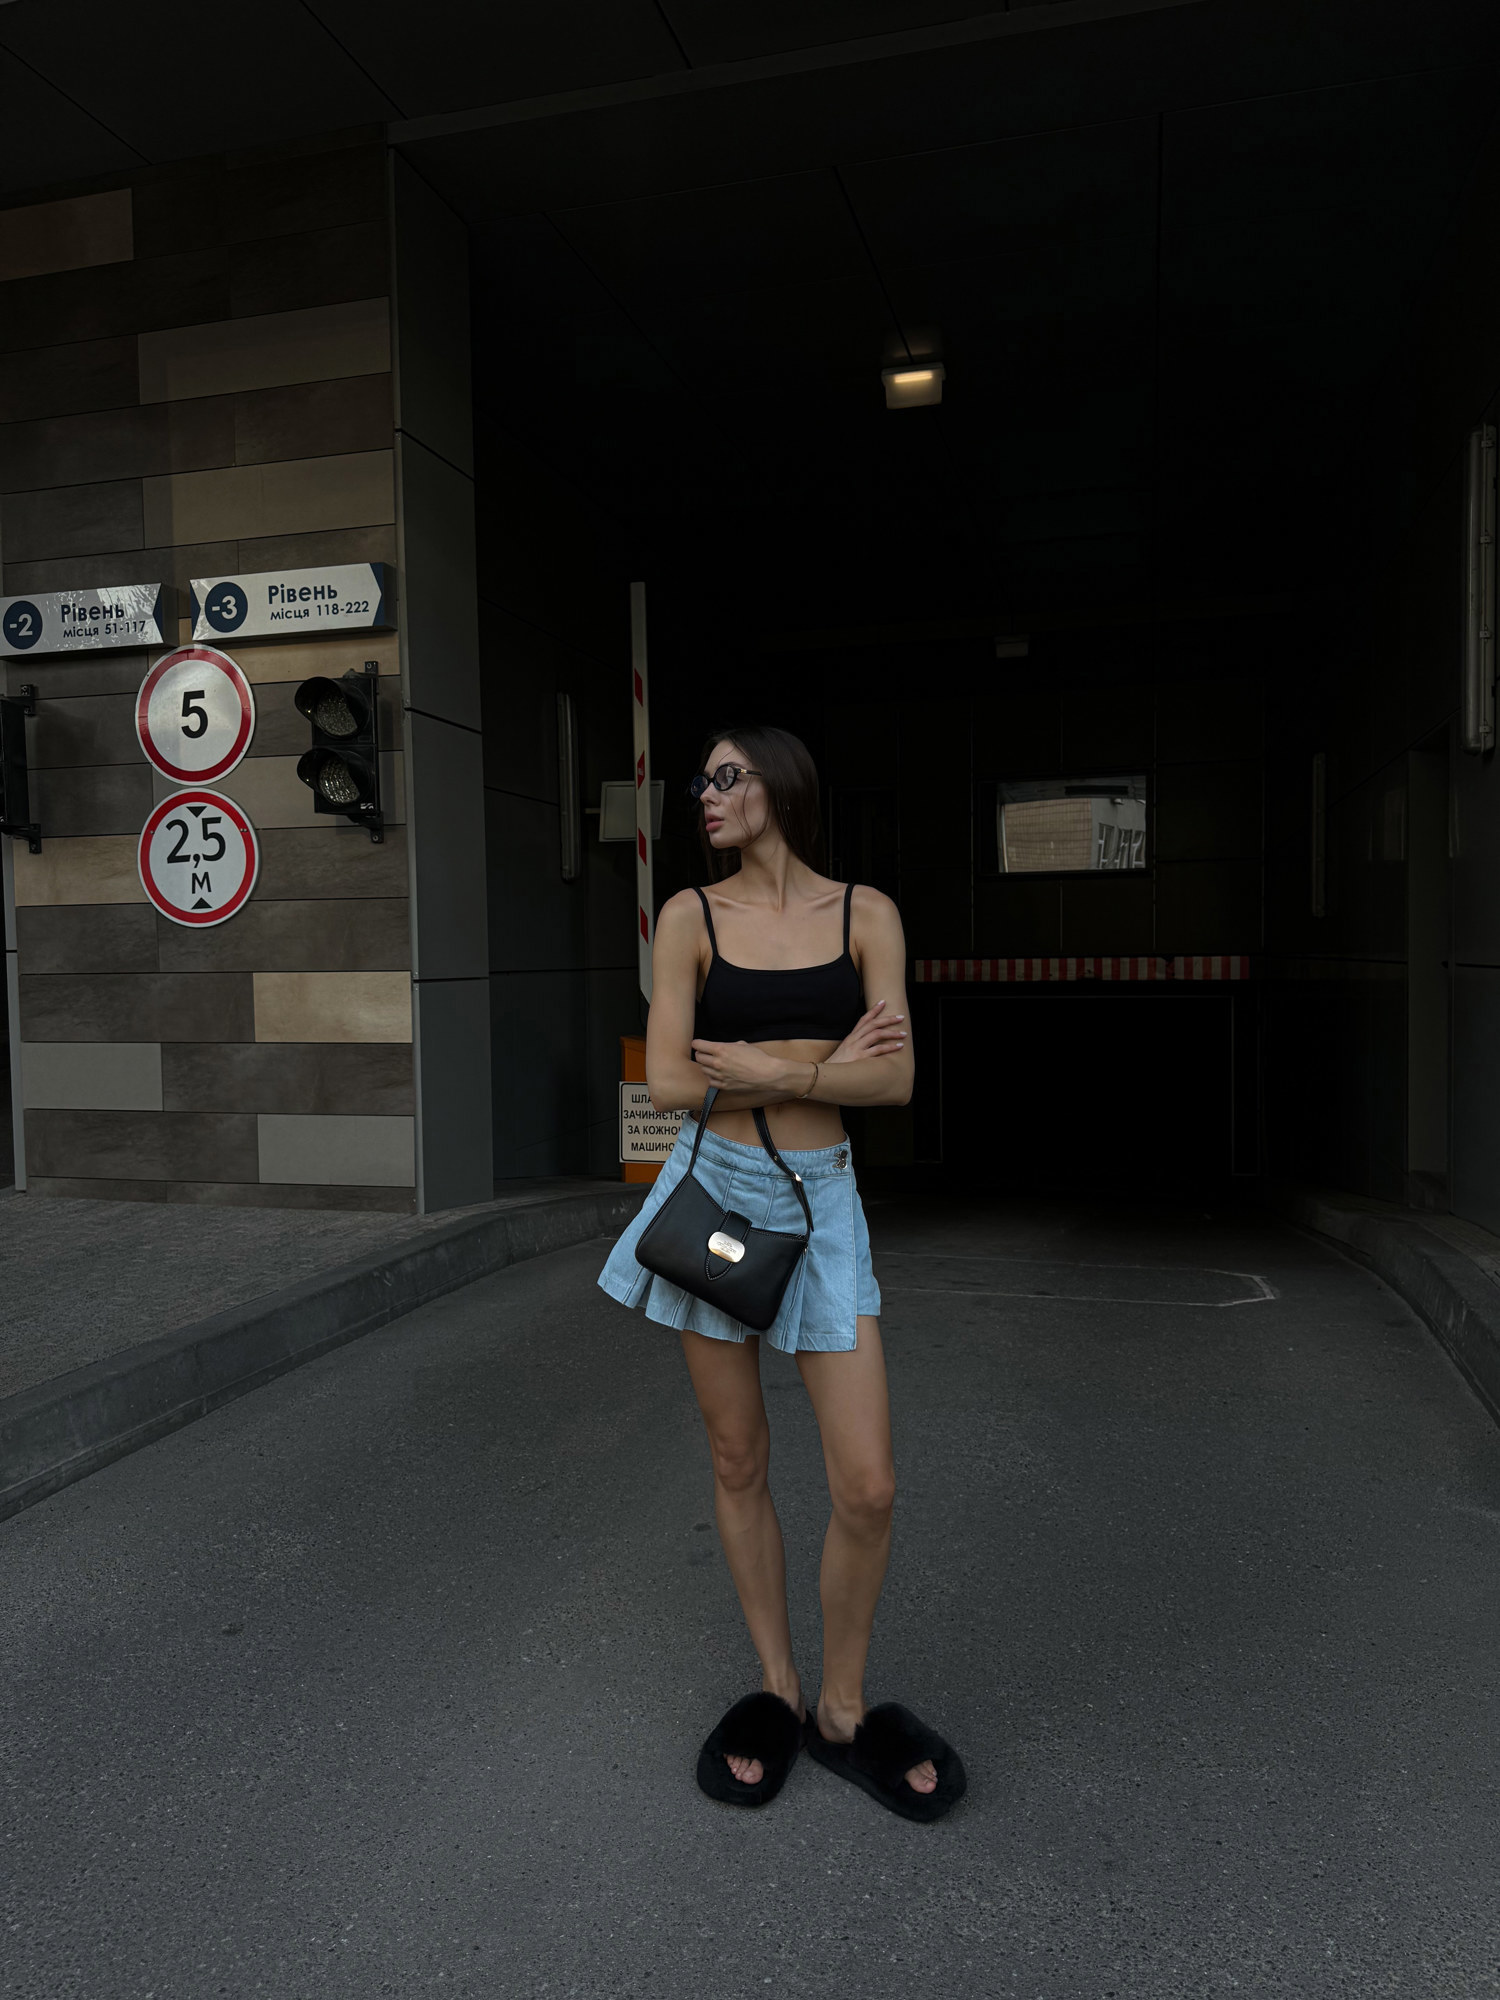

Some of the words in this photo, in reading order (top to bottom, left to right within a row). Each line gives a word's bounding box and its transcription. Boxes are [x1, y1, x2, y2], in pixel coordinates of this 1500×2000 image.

[268, 583, 338, 605] Рівень
[61, 602, 125, 623] Рівень
[211, 595, 238, 620] -3
[270, 608, 310, 621] місця
[316, 600, 369, 617] 118-222
[9, 613, 33, 637] -2
[63, 626, 99, 638] місця
[104, 620, 146, 635] 51-117
[181, 689, 208, 739] 5
[165, 816, 226, 869] 2,5
[631, 1094, 652, 1104] ШЛА
[623, 1109, 687, 1121] ЗАЧИНЯЄТЬС
[627, 1125, 640, 1135] ЗА
[643, 1125, 680, 1136] КОЖНО
[631, 1142, 675, 1152] МАШИНО
